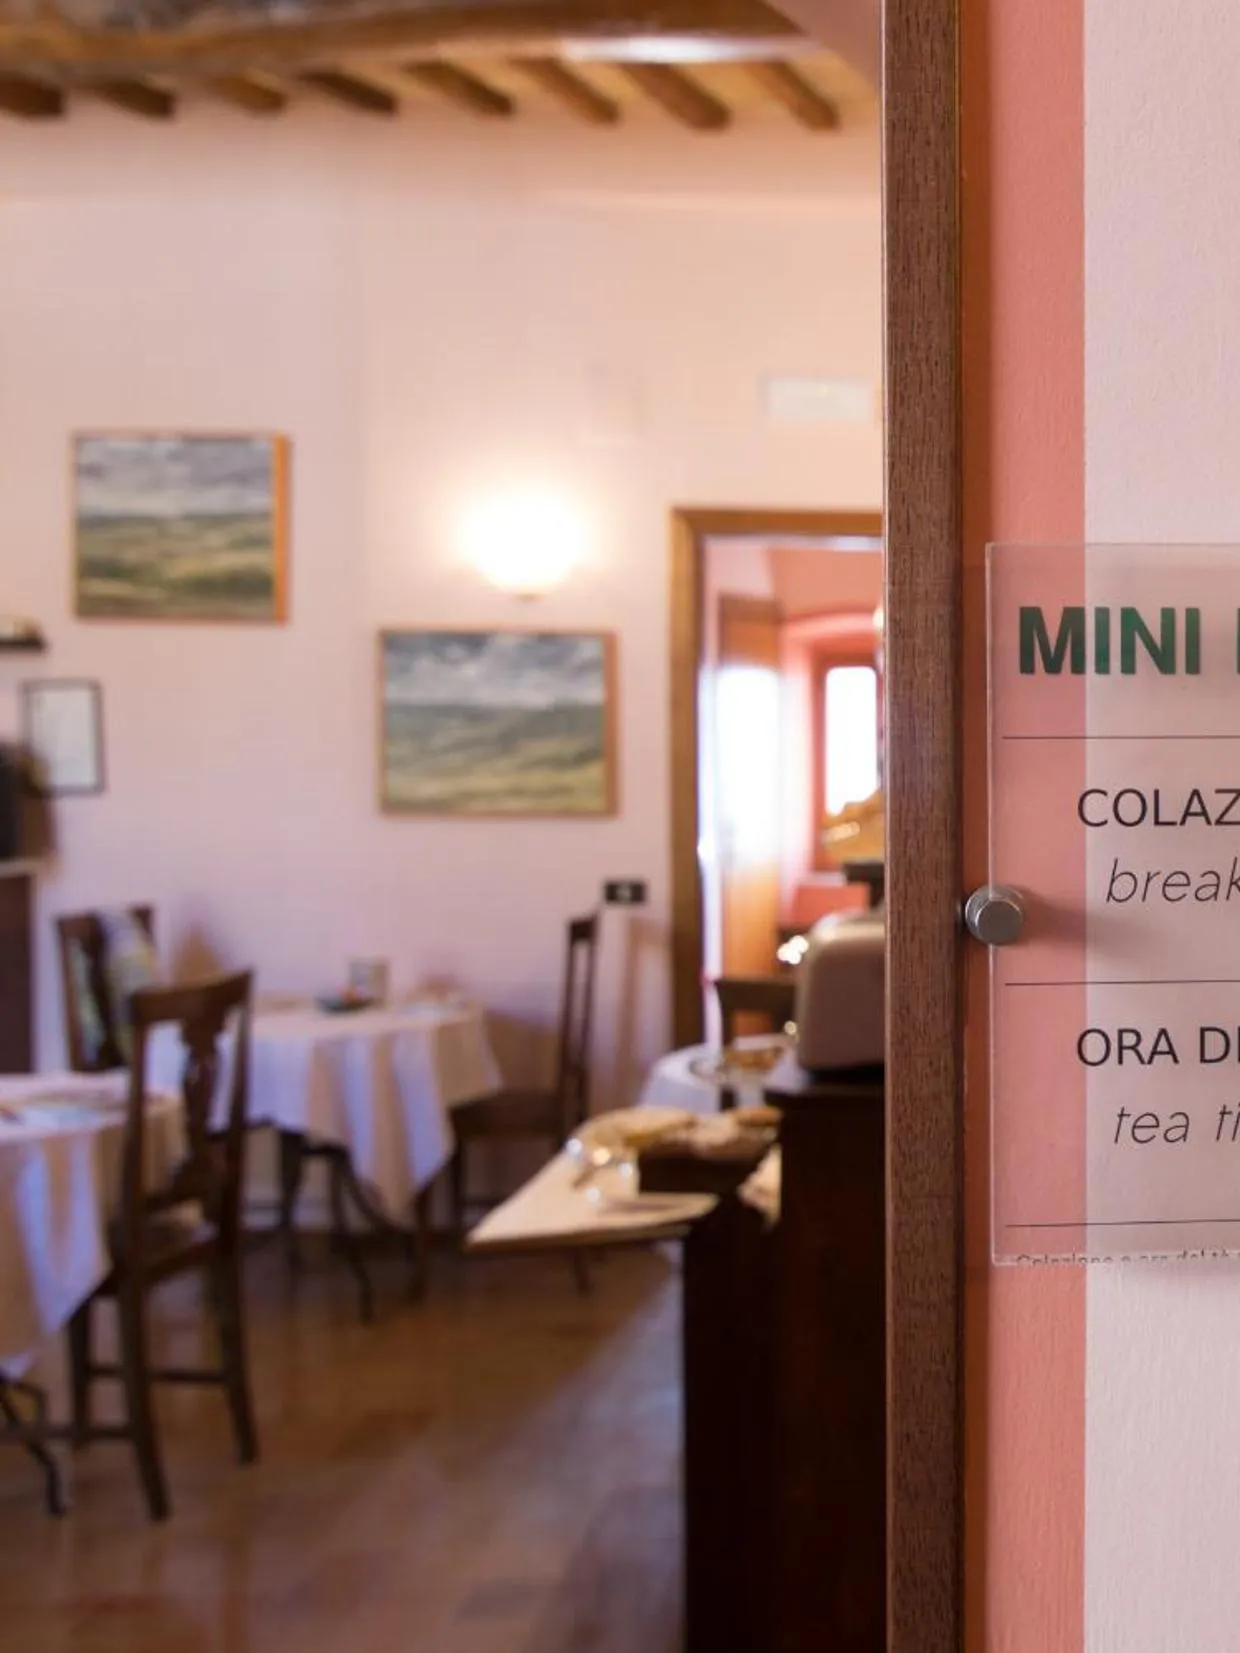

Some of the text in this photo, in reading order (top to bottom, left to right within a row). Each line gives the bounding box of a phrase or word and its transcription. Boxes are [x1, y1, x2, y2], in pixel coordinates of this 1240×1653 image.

[1019, 606, 1200, 676] MINI
[1077, 1028, 1179, 1066] ORA
[1113, 1107, 1190, 1143] tea
